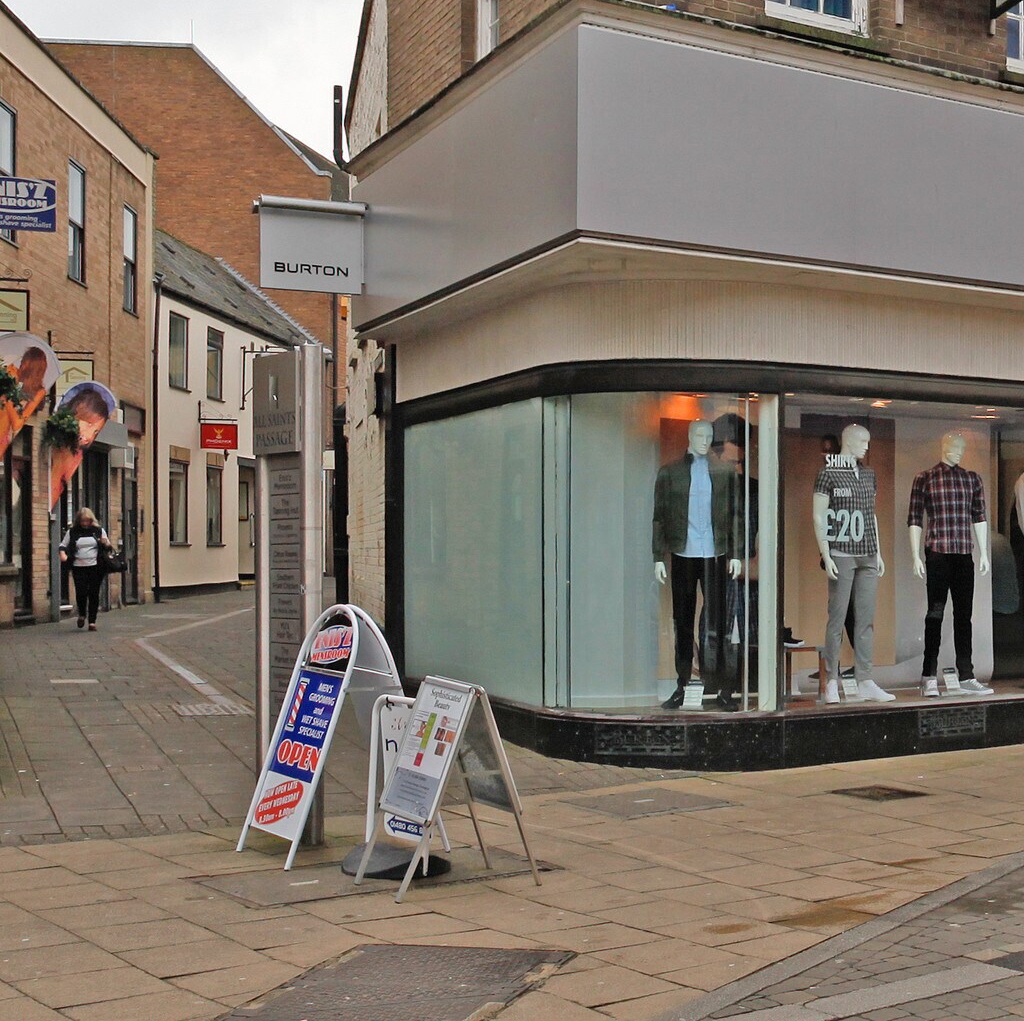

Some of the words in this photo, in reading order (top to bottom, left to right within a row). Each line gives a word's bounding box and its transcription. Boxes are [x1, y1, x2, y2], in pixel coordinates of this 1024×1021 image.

[274, 261, 349, 278] BURTON
[256, 430, 294, 447] PASSAGE
[825, 454, 857, 467] SHIRTS
[833, 488, 852, 497] FROM
[822, 509, 865, 542] £20
[318, 682, 334, 693] MEN'S
[309, 692, 335, 706] GROOMING
[431, 688, 463, 702] Sophisticated
[313, 707, 325, 715] and
[434, 700, 451, 710] Beauty
[301, 715, 313, 724] WET
[312, 717, 328, 728] SHAVE
[298, 725, 325, 739] SPECIALIST
[277, 738, 322, 773] OPEN
[274, 784, 287, 795] OPEN
[286, 781, 298, 791] LATE
[258, 800, 273, 812] EVERY
[272, 791, 300, 807] WEDNESDAY
